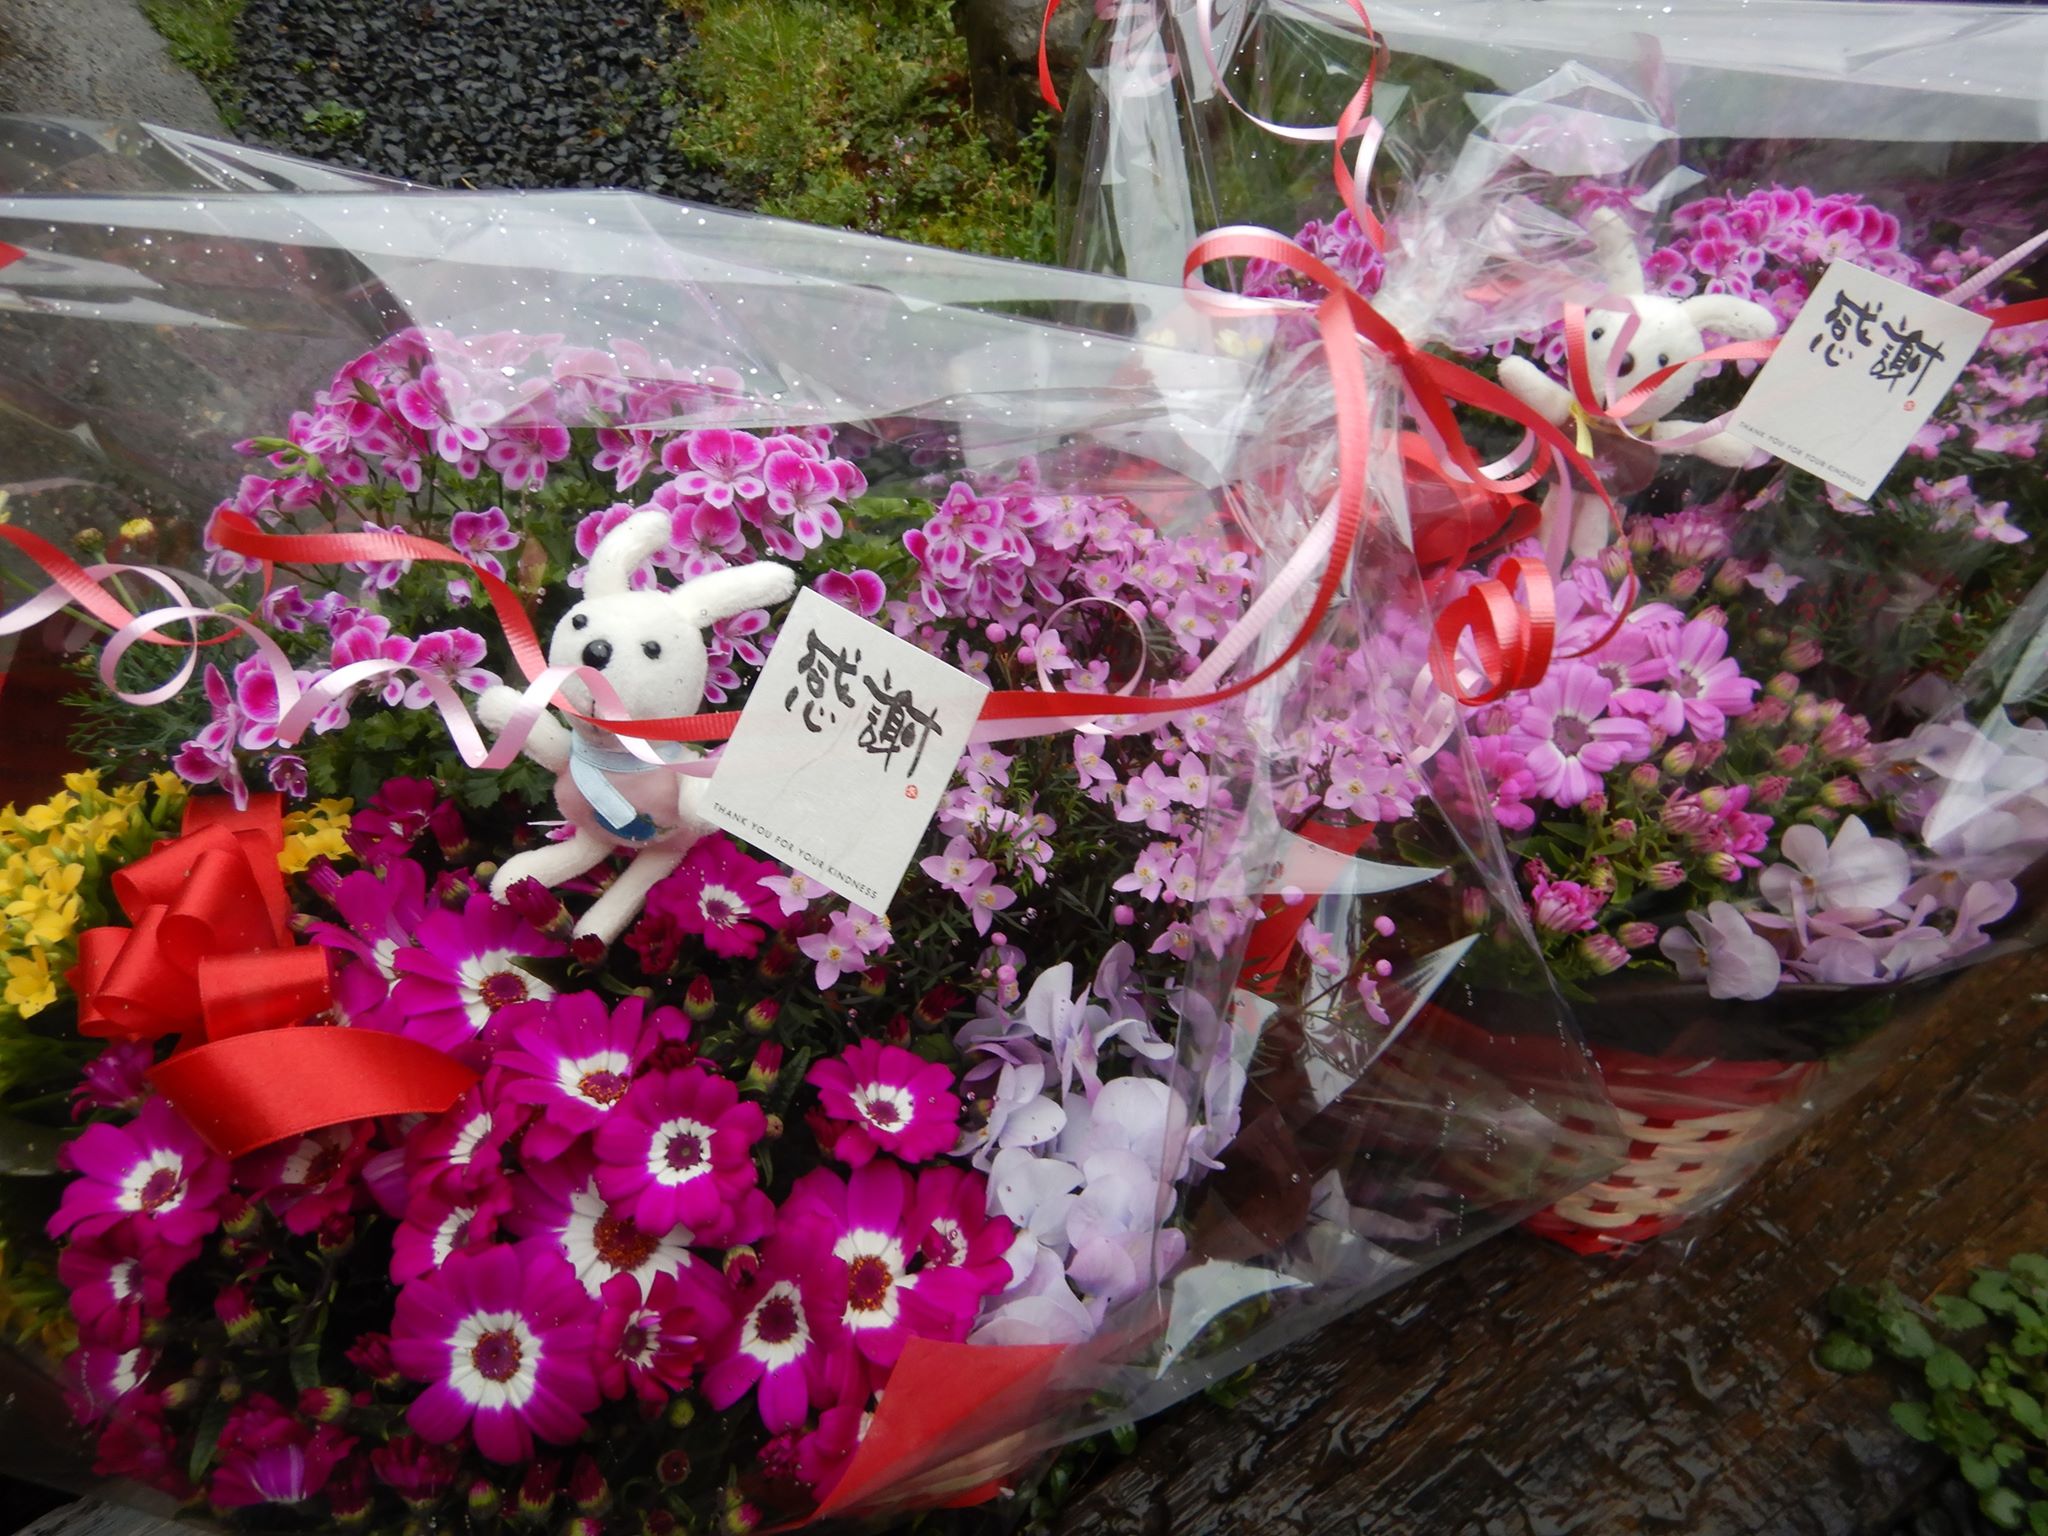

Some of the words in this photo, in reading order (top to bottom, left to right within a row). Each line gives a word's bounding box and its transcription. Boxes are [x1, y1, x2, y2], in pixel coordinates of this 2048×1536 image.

[1810, 290, 1945, 395] 感謝
[785, 628, 942, 778] 感謝
[713, 802, 747, 826] THANK
[751, 823, 772, 838] YOU
[775, 836, 794, 852] FOR
[798, 849, 825, 869] YOUR
[828, 864, 878, 900] KINDNESS
